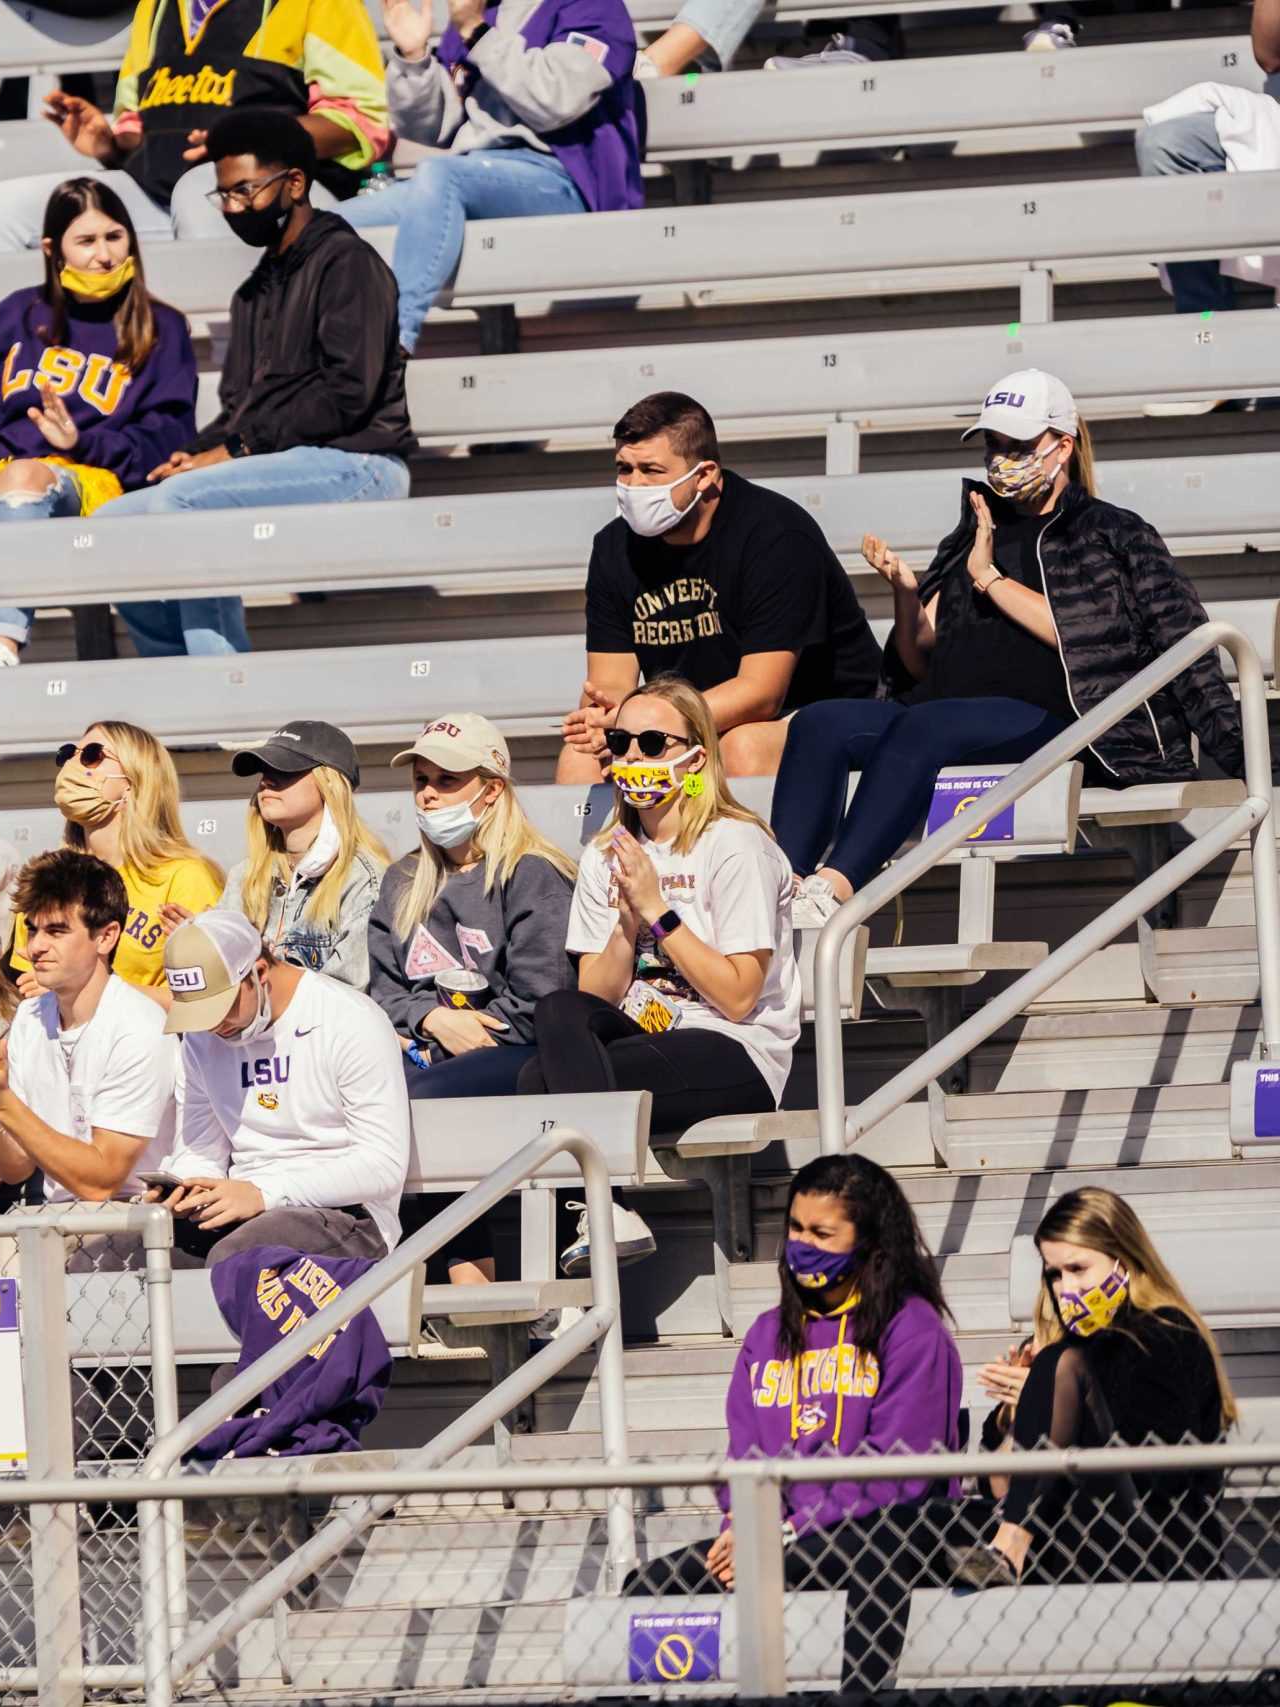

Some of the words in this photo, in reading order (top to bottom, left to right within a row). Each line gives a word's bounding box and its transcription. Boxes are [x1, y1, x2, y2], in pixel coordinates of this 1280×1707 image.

[1221, 52, 1236, 66] 13
[140, 66, 238, 109] Cheetos
[861, 79, 873, 91] 11
[1021, 201, 1035, 215] 13
[662, 226, 674, 238] 11
[480, 236, 493, 250] 10
[1195, 331, 1209, 345] 15
[822, 353, 836, 367] 13
[1, 340, 132, 416] LSU
[459, 376, 472, 389] 11
[984, 391, 1026, 409] LSU
[412, 661, 426, 675] 13
[423, 722, 462, 739] LSU
[652, 768, 670, 778] LSU
[576, 803, 591, 816] 15
[198, 819, 213, 833] 13
[167, 972, 199, 988] LSU
[240, 1056, 291, 1089] LSU
[1260, 1073, 1280, 1083] THIS
[538, 1119, 554, 1133] 17
[750, 1358, 794, 1408] LSU
[794, 1343, 881, 1398] TIGERS
